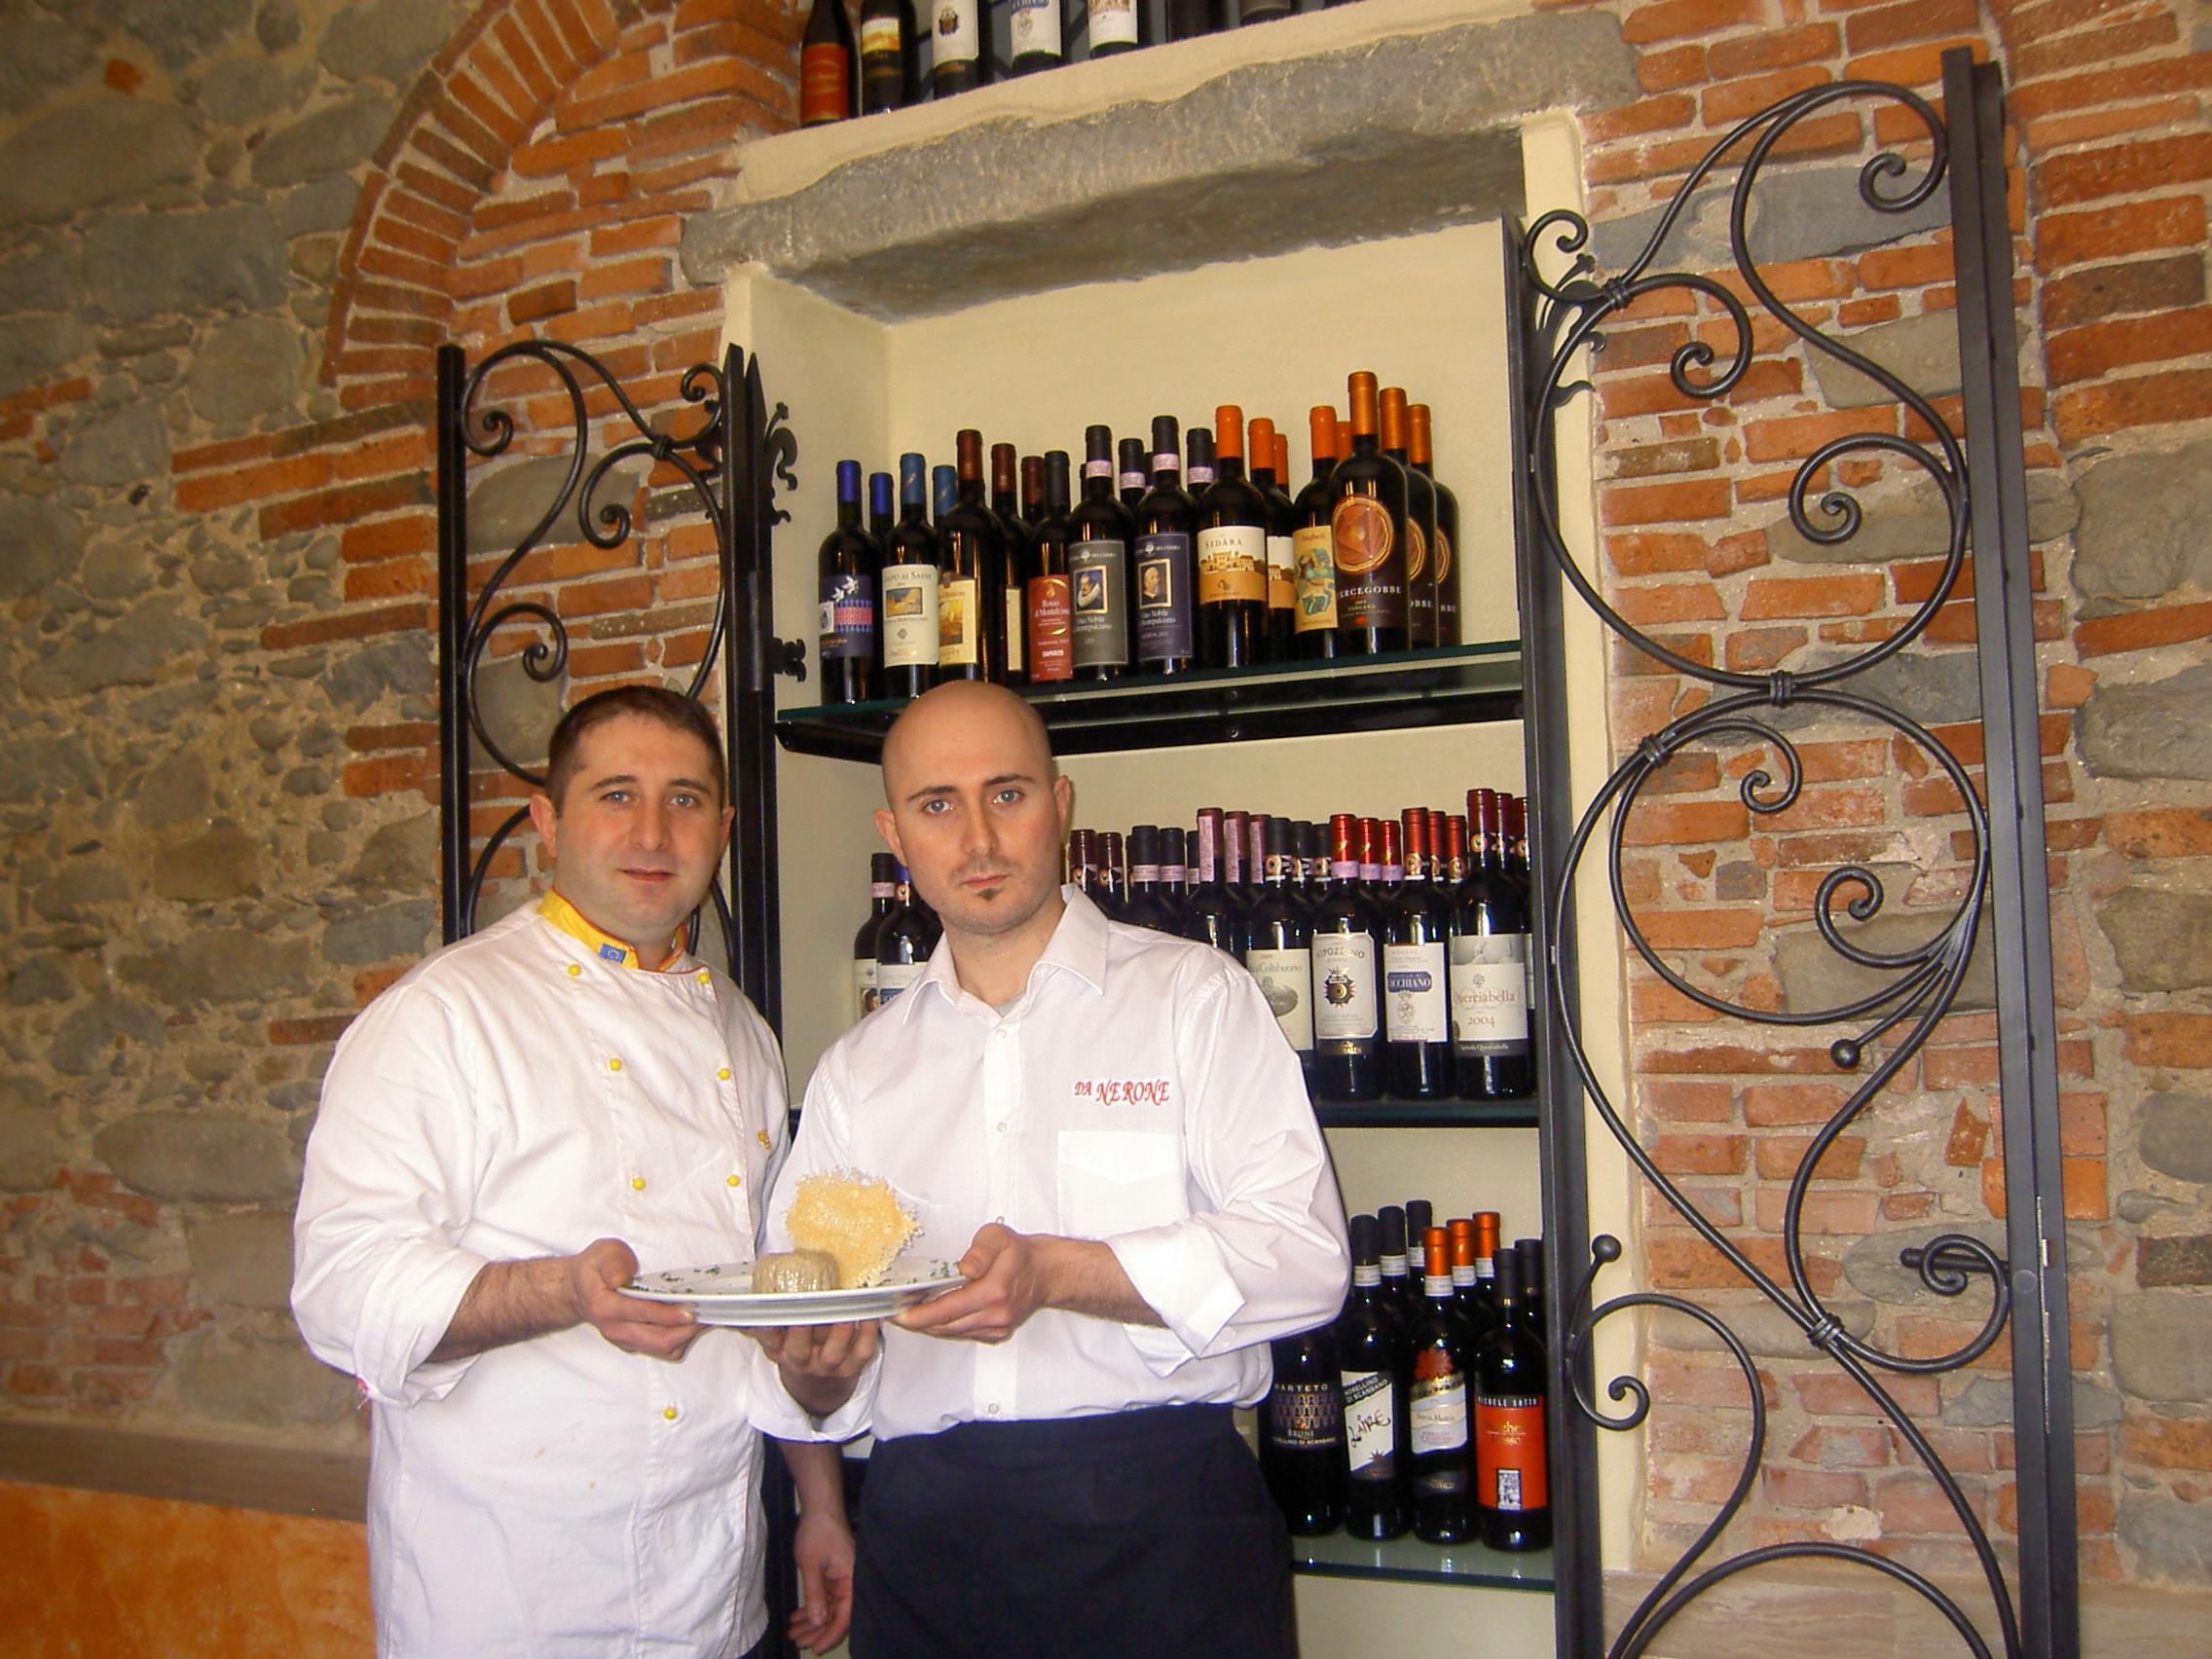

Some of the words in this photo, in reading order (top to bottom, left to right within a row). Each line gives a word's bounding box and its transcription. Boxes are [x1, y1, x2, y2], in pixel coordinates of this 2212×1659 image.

[1467, 1015, 1495, 1028] 2004
[1074, 1081, 1091, 1095] DA
[1095, 1079, 1170, 1106] NERONE
